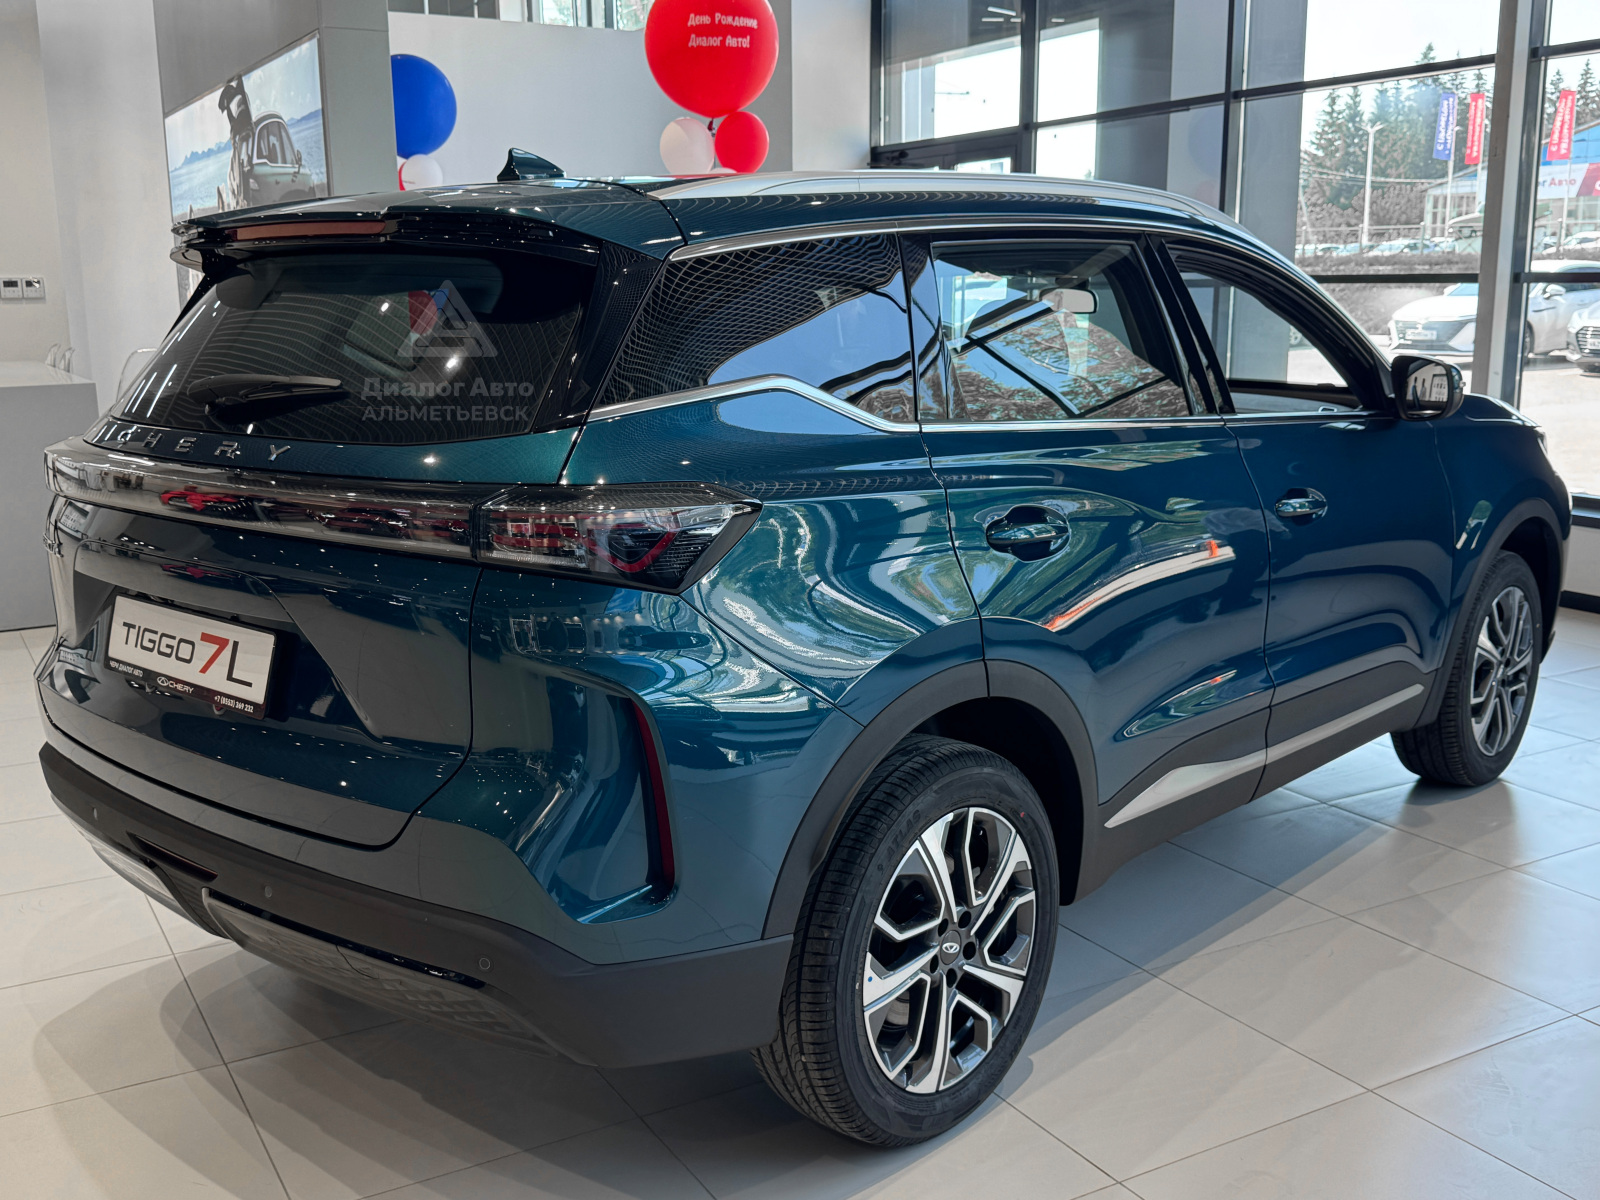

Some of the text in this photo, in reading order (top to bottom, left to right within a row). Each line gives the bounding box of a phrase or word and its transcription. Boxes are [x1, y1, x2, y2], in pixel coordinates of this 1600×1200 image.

[687, 13, 711, 27] День
[688, 34, 750, 48] Диалог Авто!
[168, 680, 194, 694] CHERY
